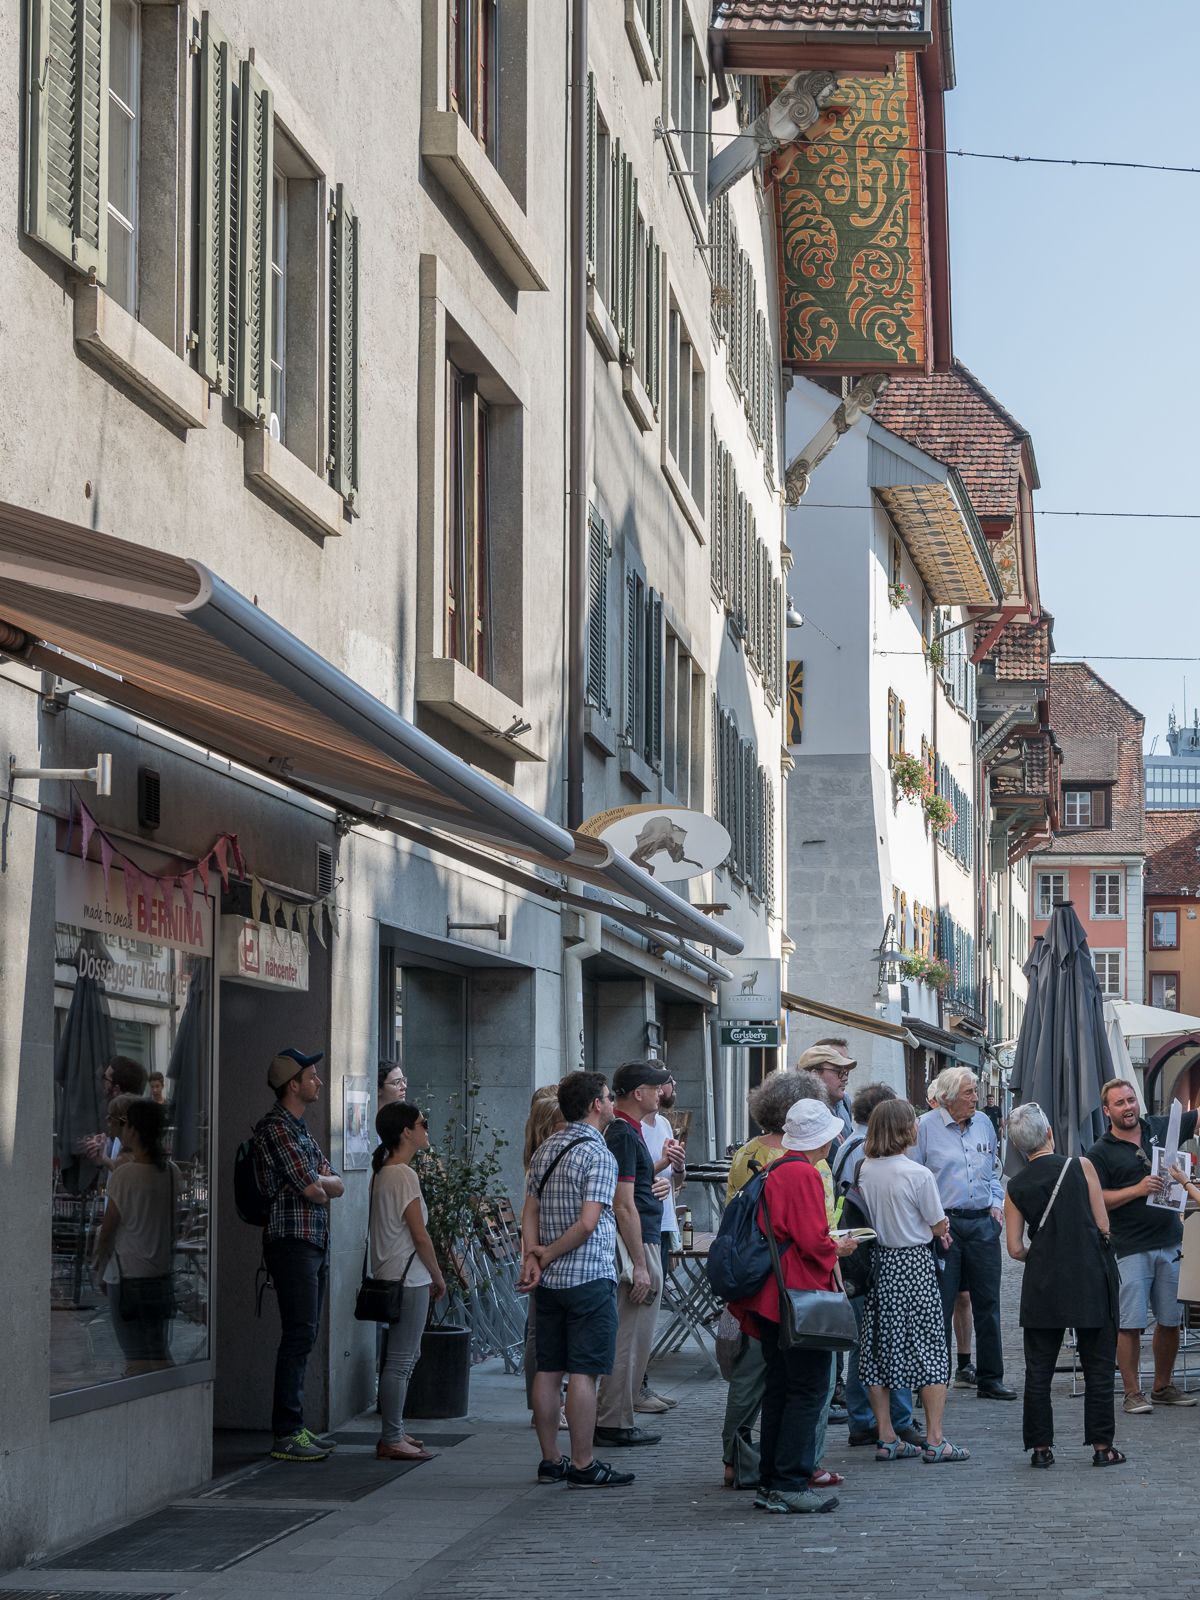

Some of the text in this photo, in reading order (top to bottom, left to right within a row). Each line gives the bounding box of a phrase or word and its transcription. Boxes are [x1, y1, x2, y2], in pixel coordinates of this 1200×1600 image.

[83, 894, 204, 947] made to create BERNINA
[79, 948, 138, 993] Dössegger
[265, 956, 298, 983] nähcenter
[730, 1028, 768, 1042] Carlsberg
